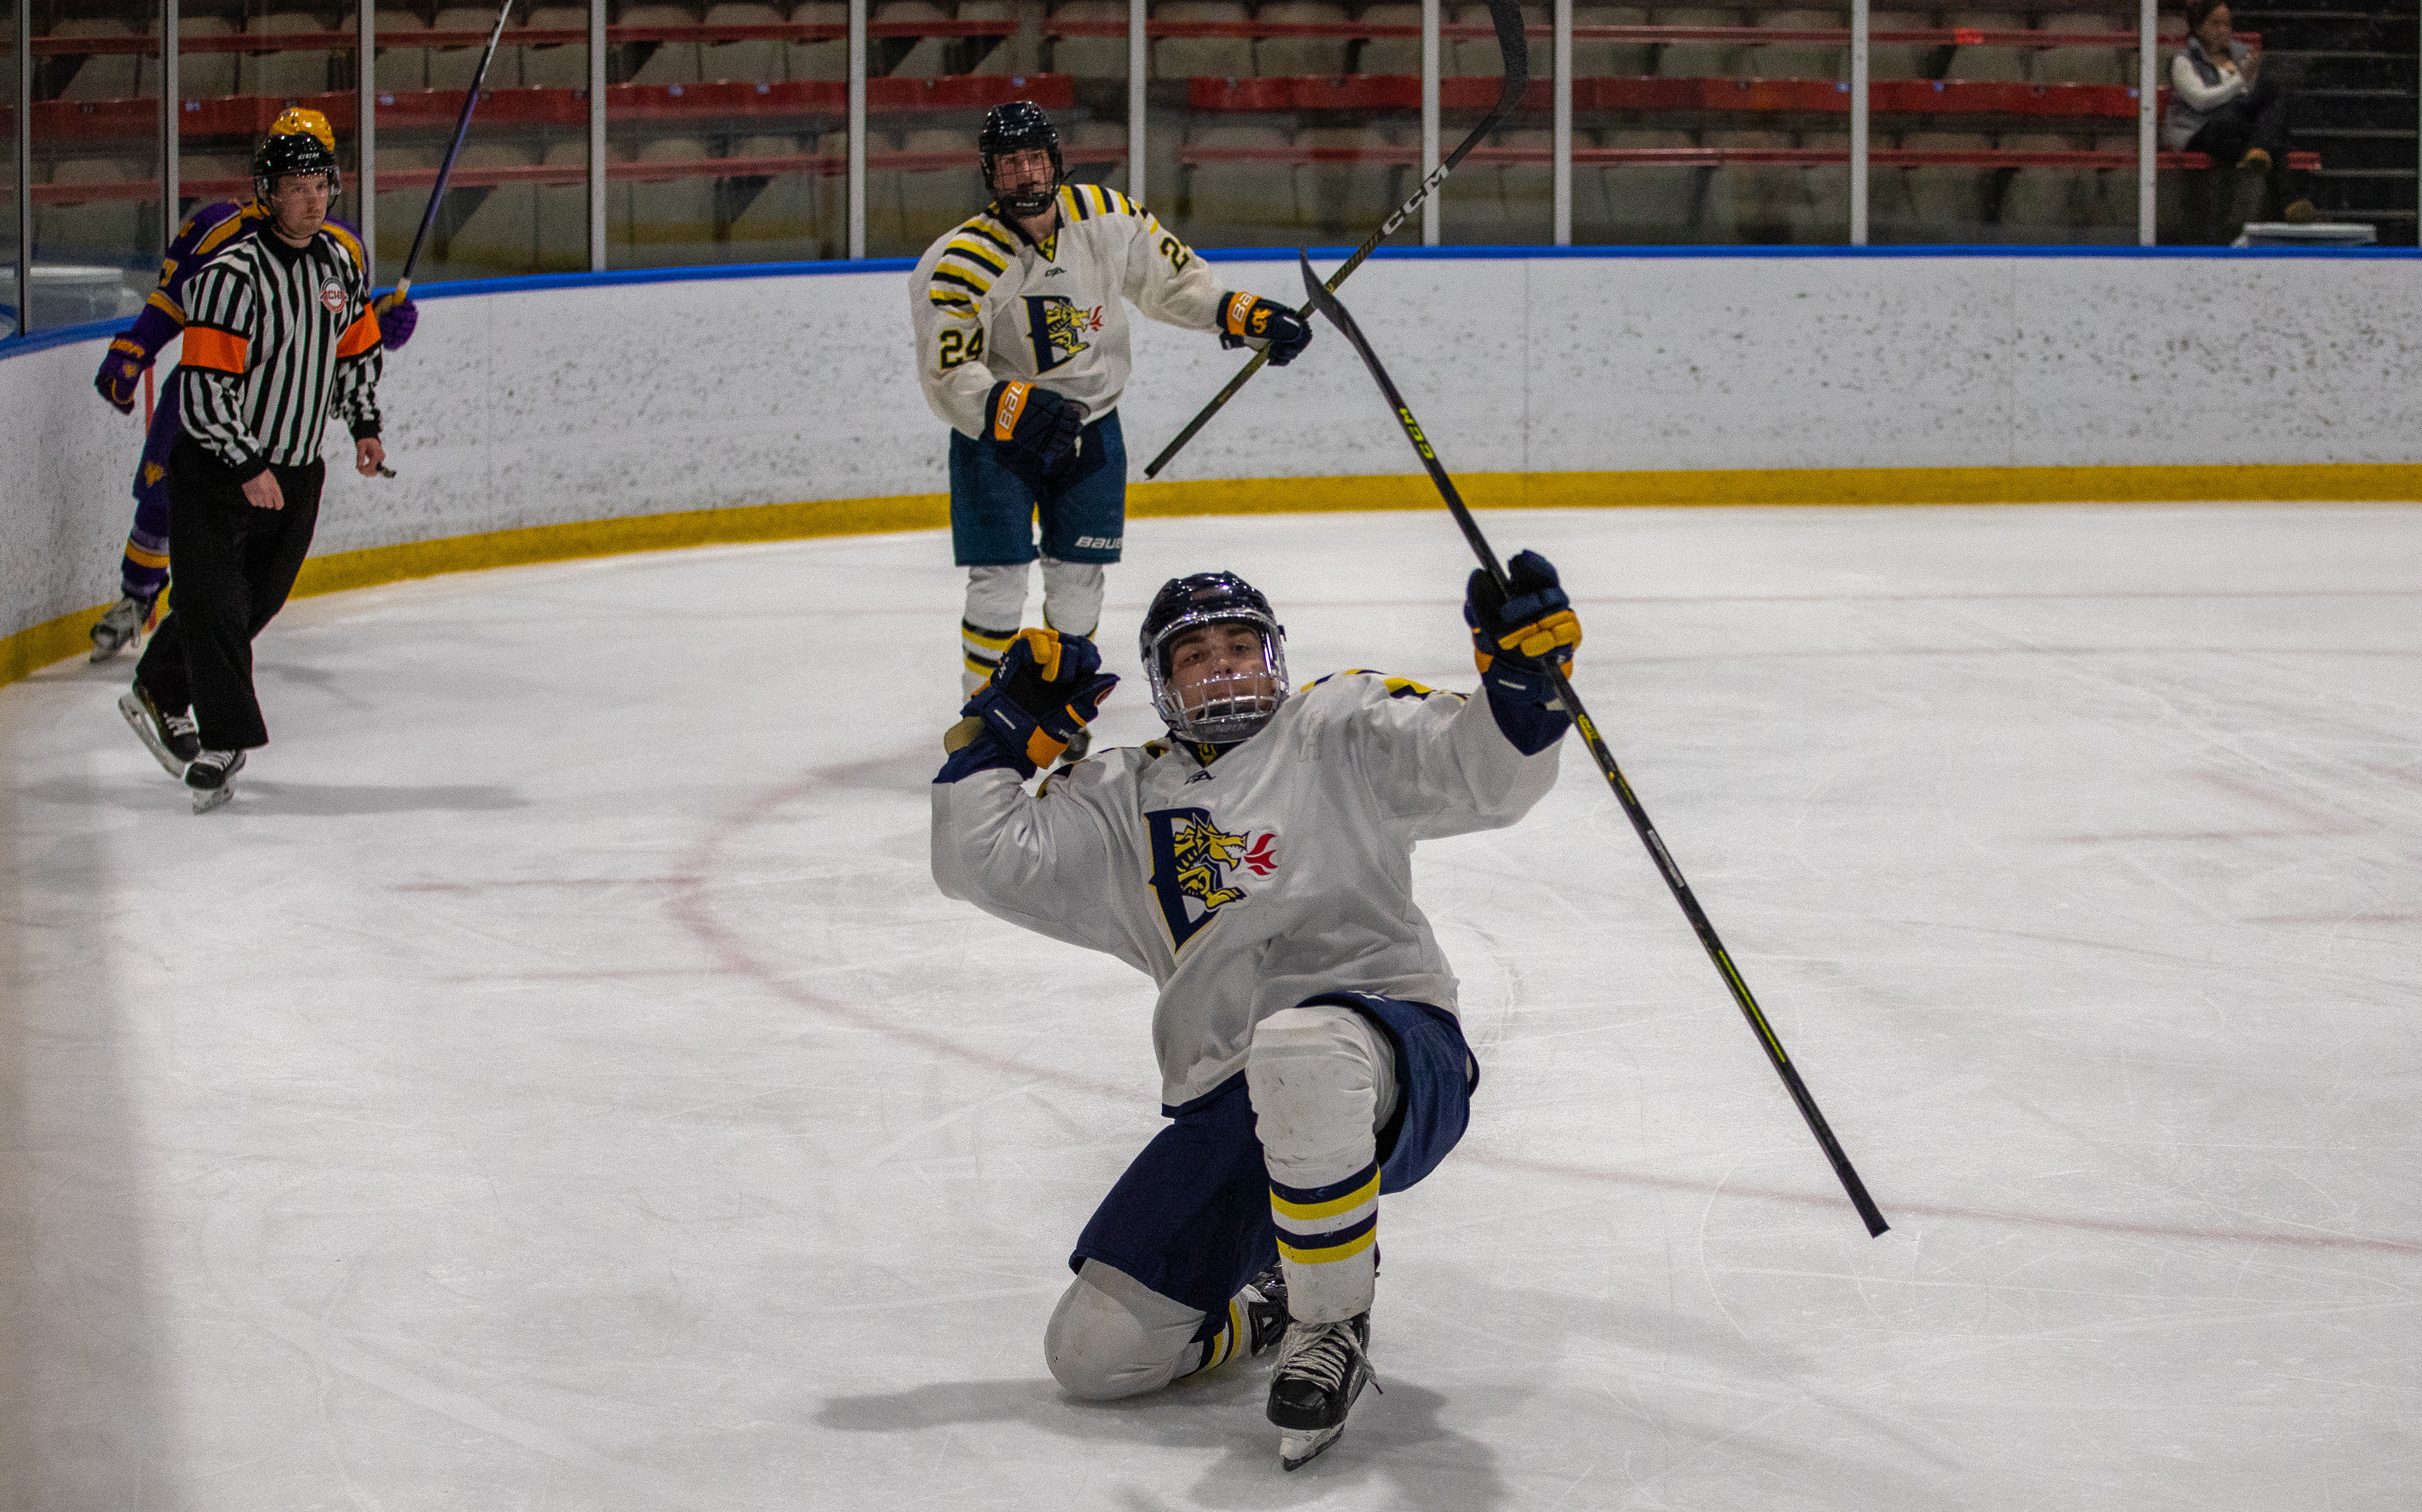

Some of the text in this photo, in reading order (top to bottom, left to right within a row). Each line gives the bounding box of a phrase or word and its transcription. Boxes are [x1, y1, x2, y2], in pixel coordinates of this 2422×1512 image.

[1382, 164, 1449, 235] CCM
[1159, 236, 1190, 274] 2
[939, 326, 985, 371] 24
